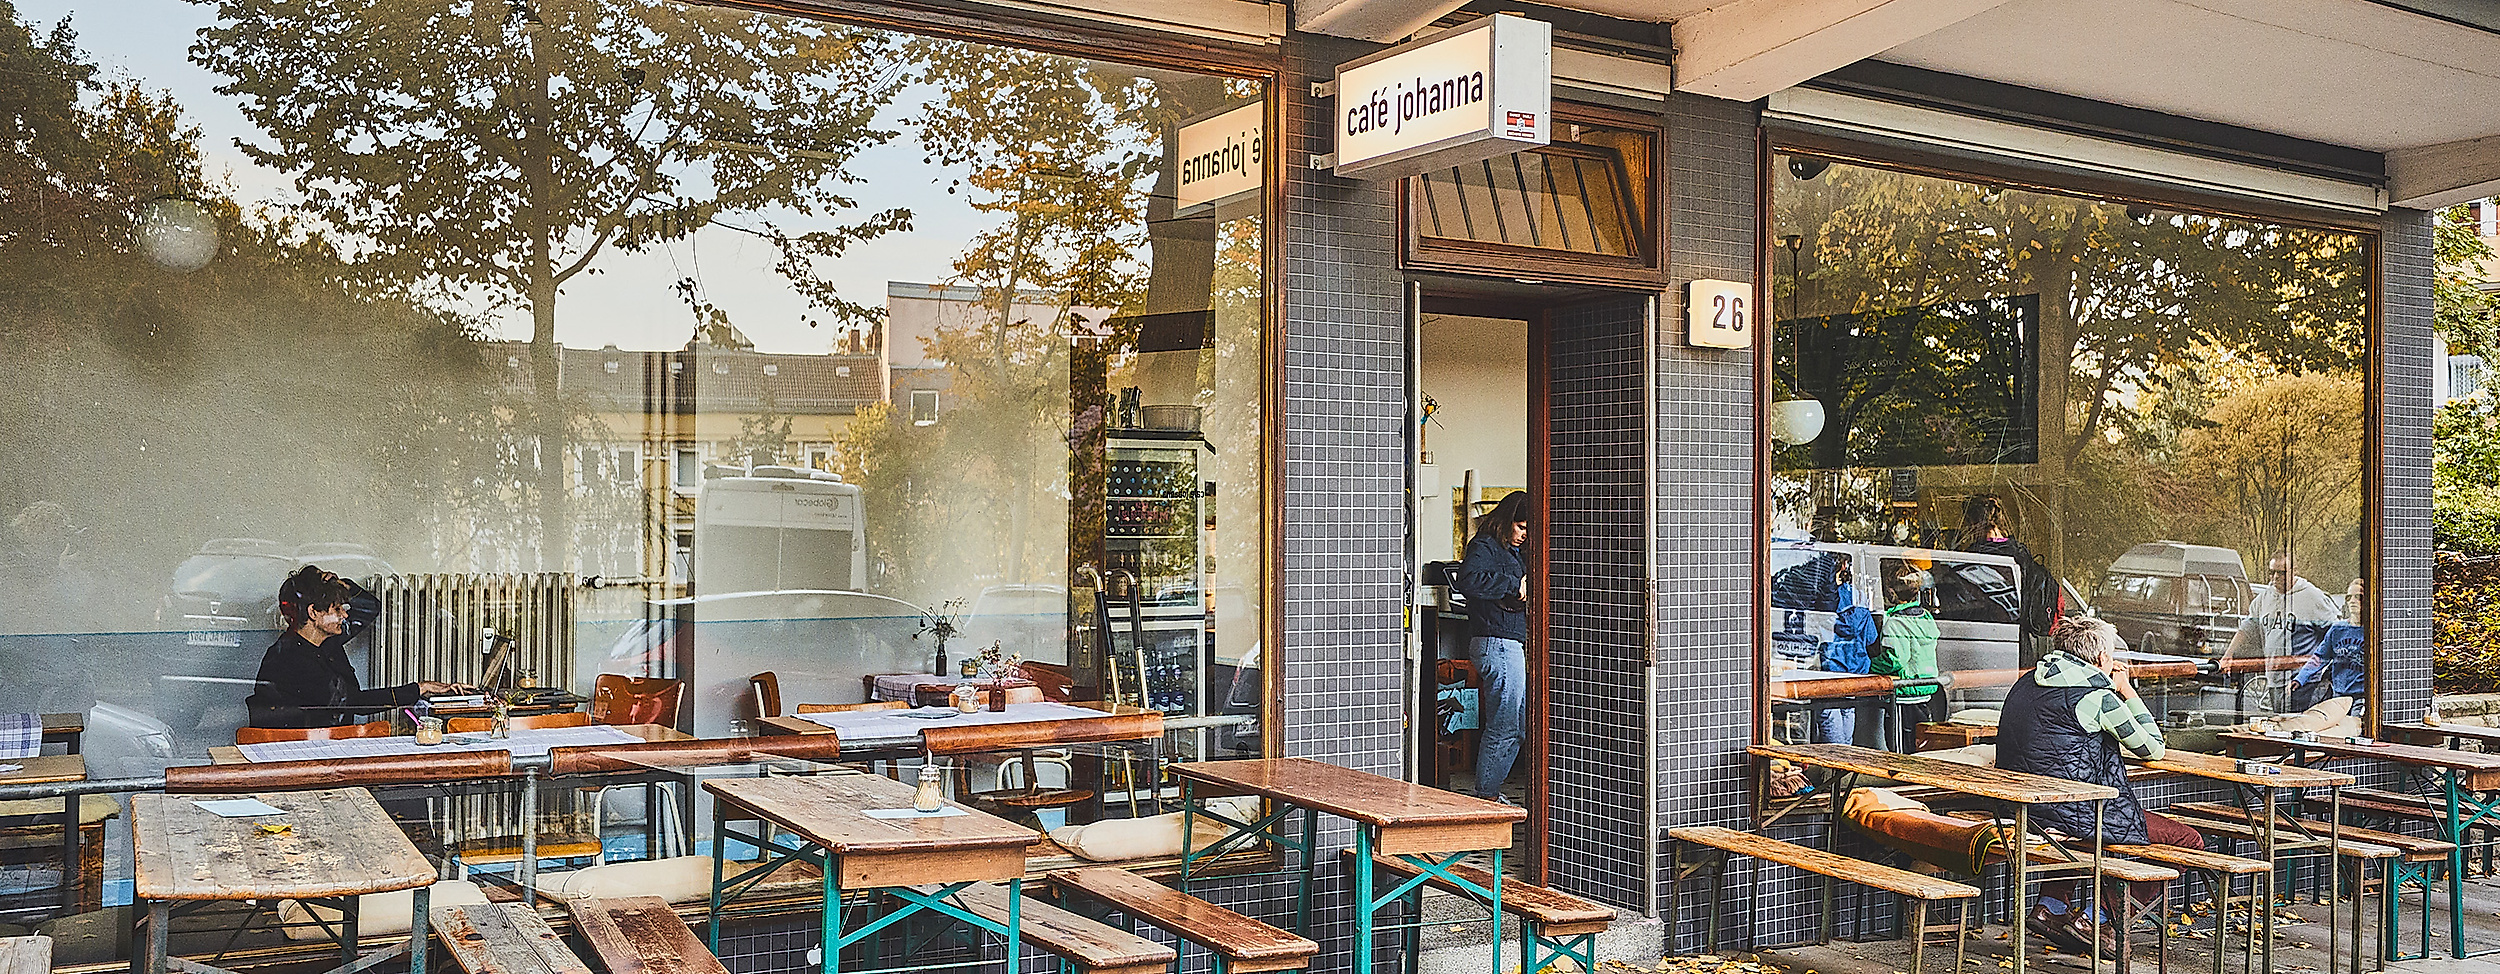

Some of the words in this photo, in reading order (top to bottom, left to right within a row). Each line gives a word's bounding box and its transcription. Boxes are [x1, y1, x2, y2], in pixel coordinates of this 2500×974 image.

[1347, 86, 1389, 136] café
[1395, 70, 1483, 136] johanna
[1713, 294, 1744, 332] 26
